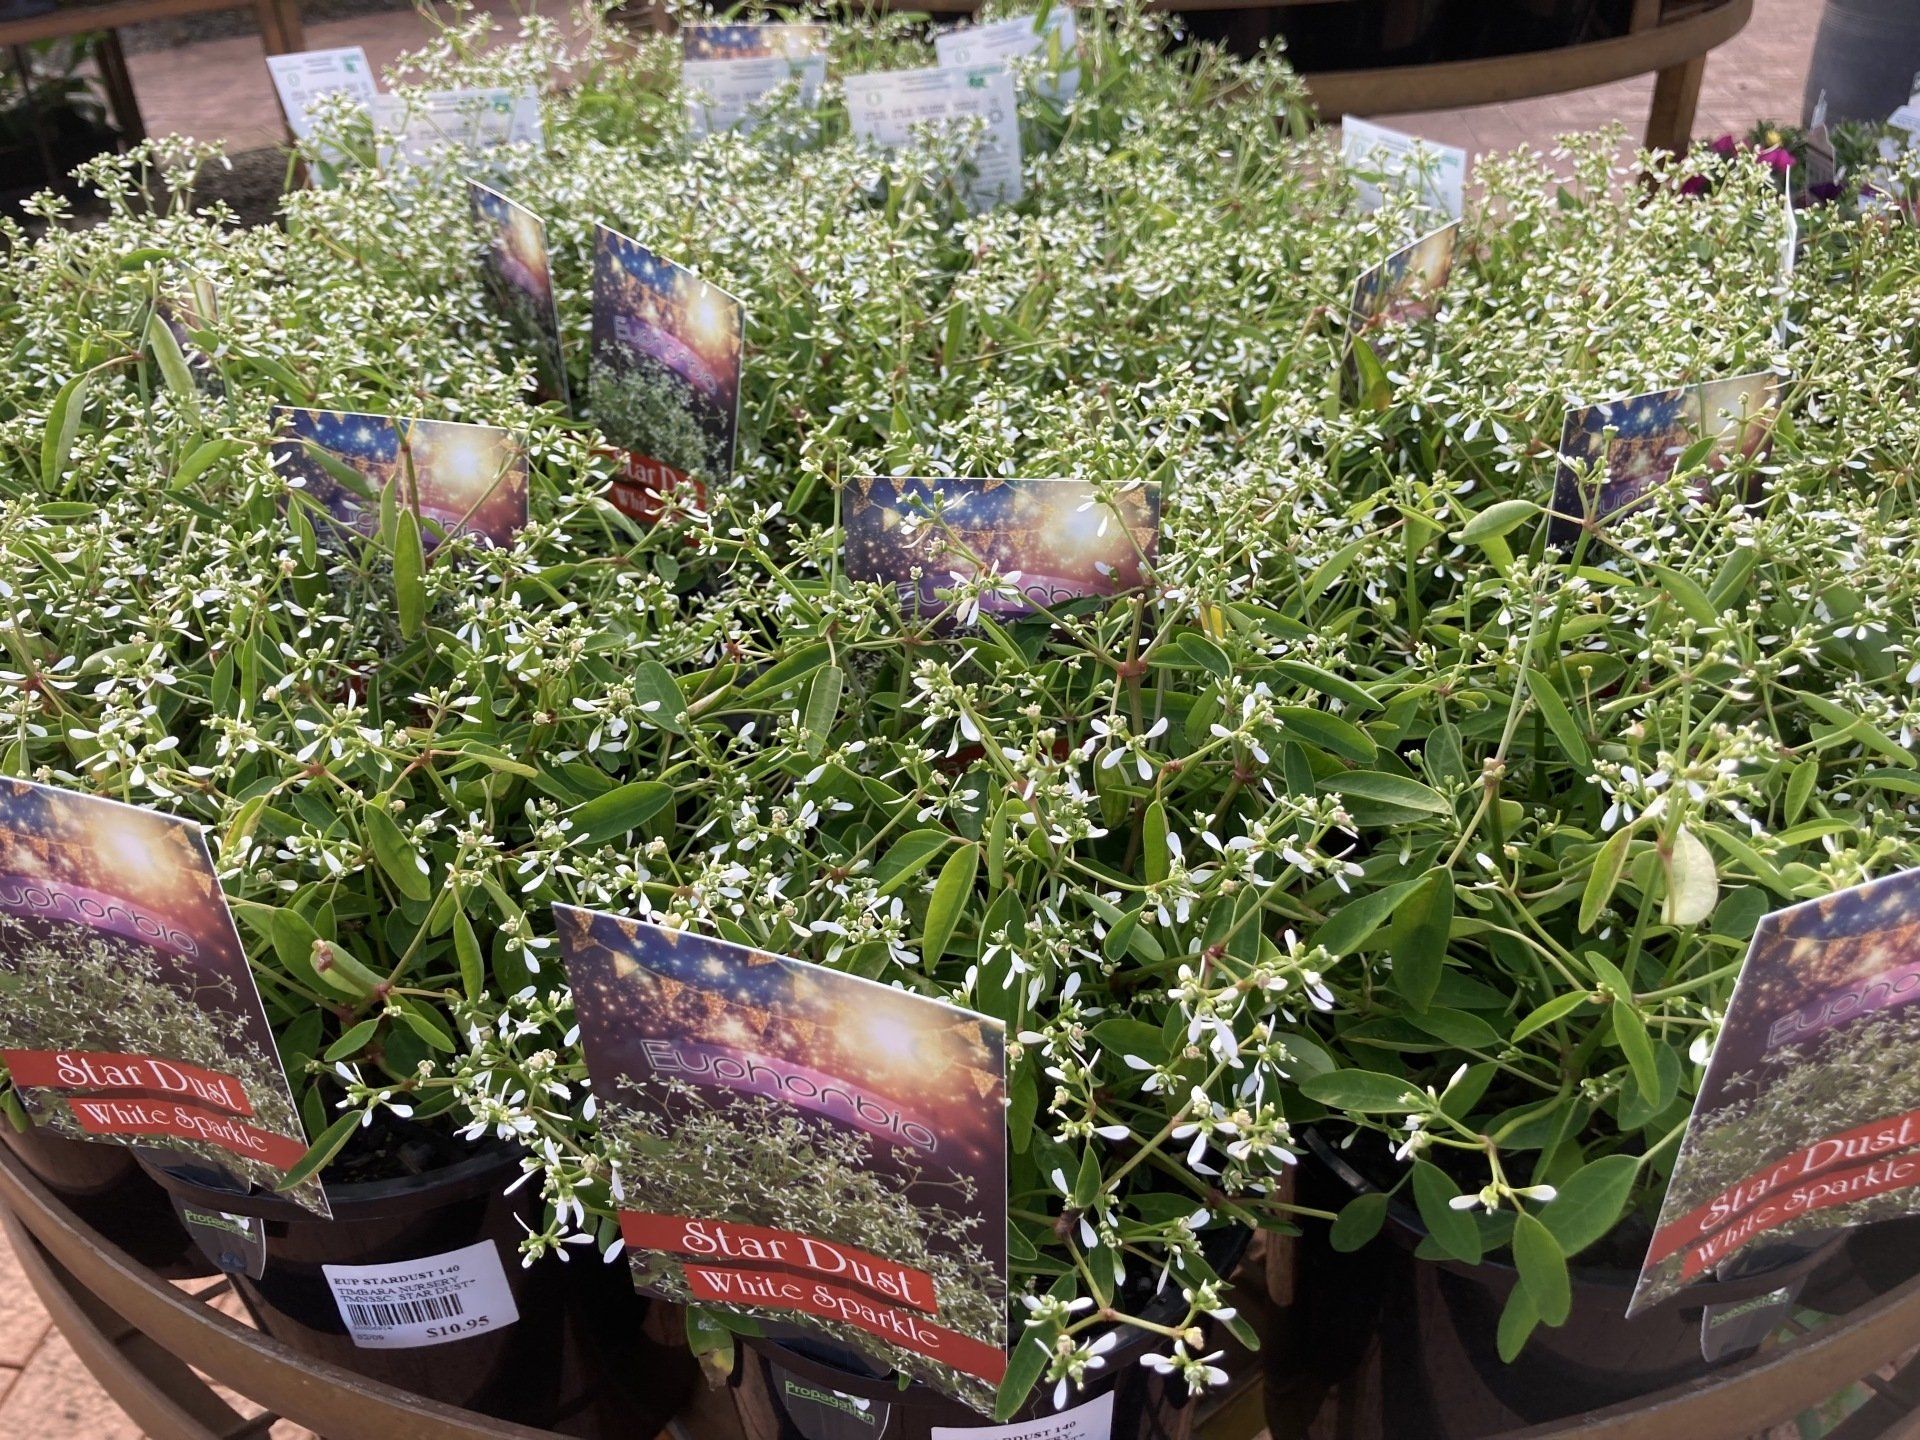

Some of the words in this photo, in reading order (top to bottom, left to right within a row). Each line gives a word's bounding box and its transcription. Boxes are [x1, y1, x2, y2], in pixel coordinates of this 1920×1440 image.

[0, 884, 200, 957] uphorbia
[1767, 972, 1920, 1049] Eupho
[55, 1054, 144, 1087] Star
[144, 1060, 241, 1111] Dust
[641, 1039, 937, 1152] Euphorbia
[80, 1103, 170, 1126] White
[175, 1106, 268, 1153] Sparkle
[1699, 1164, 1789, 1231] Star
[1797, 1117, 1915, 1175] Dust
[1697, 1206, 1776, 1262] White
[1783, 1162, 1915, 1212] Sparkle
[334, 1277, 359, 1286] EUP
[363, 1270, 434, 1286] STARDUST
[438, 1264, 460, 1276] 140
[337, 1287, 397, 1296] TIMBARA
[398, 1275, 460, 1293] NURSERY
[399, 1289, 433, 1301] STAR
[682, 1221, 787, 1260] Star
[797, 1237, 921, 1305] Dust
[426, 1315, 490, 1338] $10.95
[698, 1270, 804, 1300] White
[812, 1285, 940, 1349] Sparkle
[1055, 1420, 1077, 1433] 140
